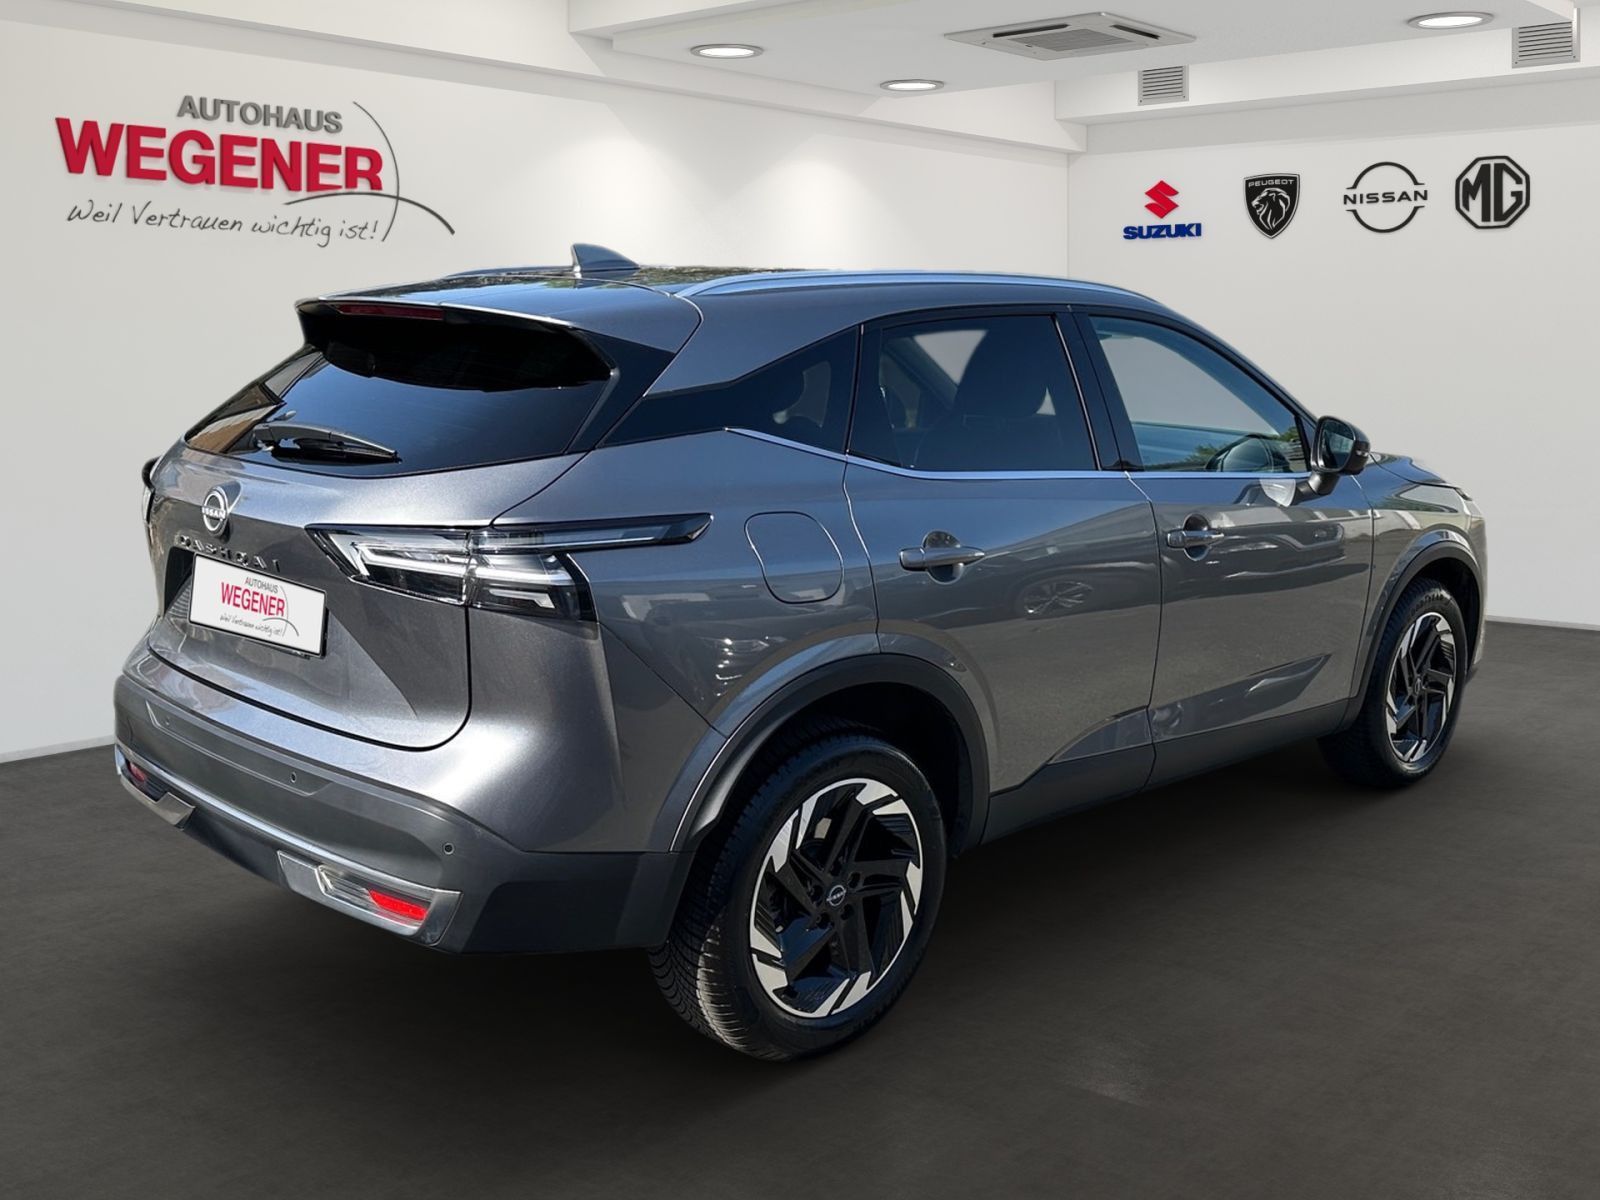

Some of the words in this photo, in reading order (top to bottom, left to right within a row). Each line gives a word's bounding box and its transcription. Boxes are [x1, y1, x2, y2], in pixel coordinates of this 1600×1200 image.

[177, 95, 342, 133] AUTOHAUS
[55, 117, 383, 193] WEGENER
[1248, 179, 1294, 187] PEUGEOT
[1343, 190, 1428, 205] NISSAN
[1462, 162, 1523, 222] MG
[67, 199, 122, 223] Weil
[132, 200, 243, 232] Vertrauen
[251, 215, 331, 248] wichtig
[339, 219, 379, 240] ist!
[1123, 222, 1202, 240] SUZUKI
[221, 582, 285, 617] WEGENER
[245, 577, 279, 594] AUTOHAUS
